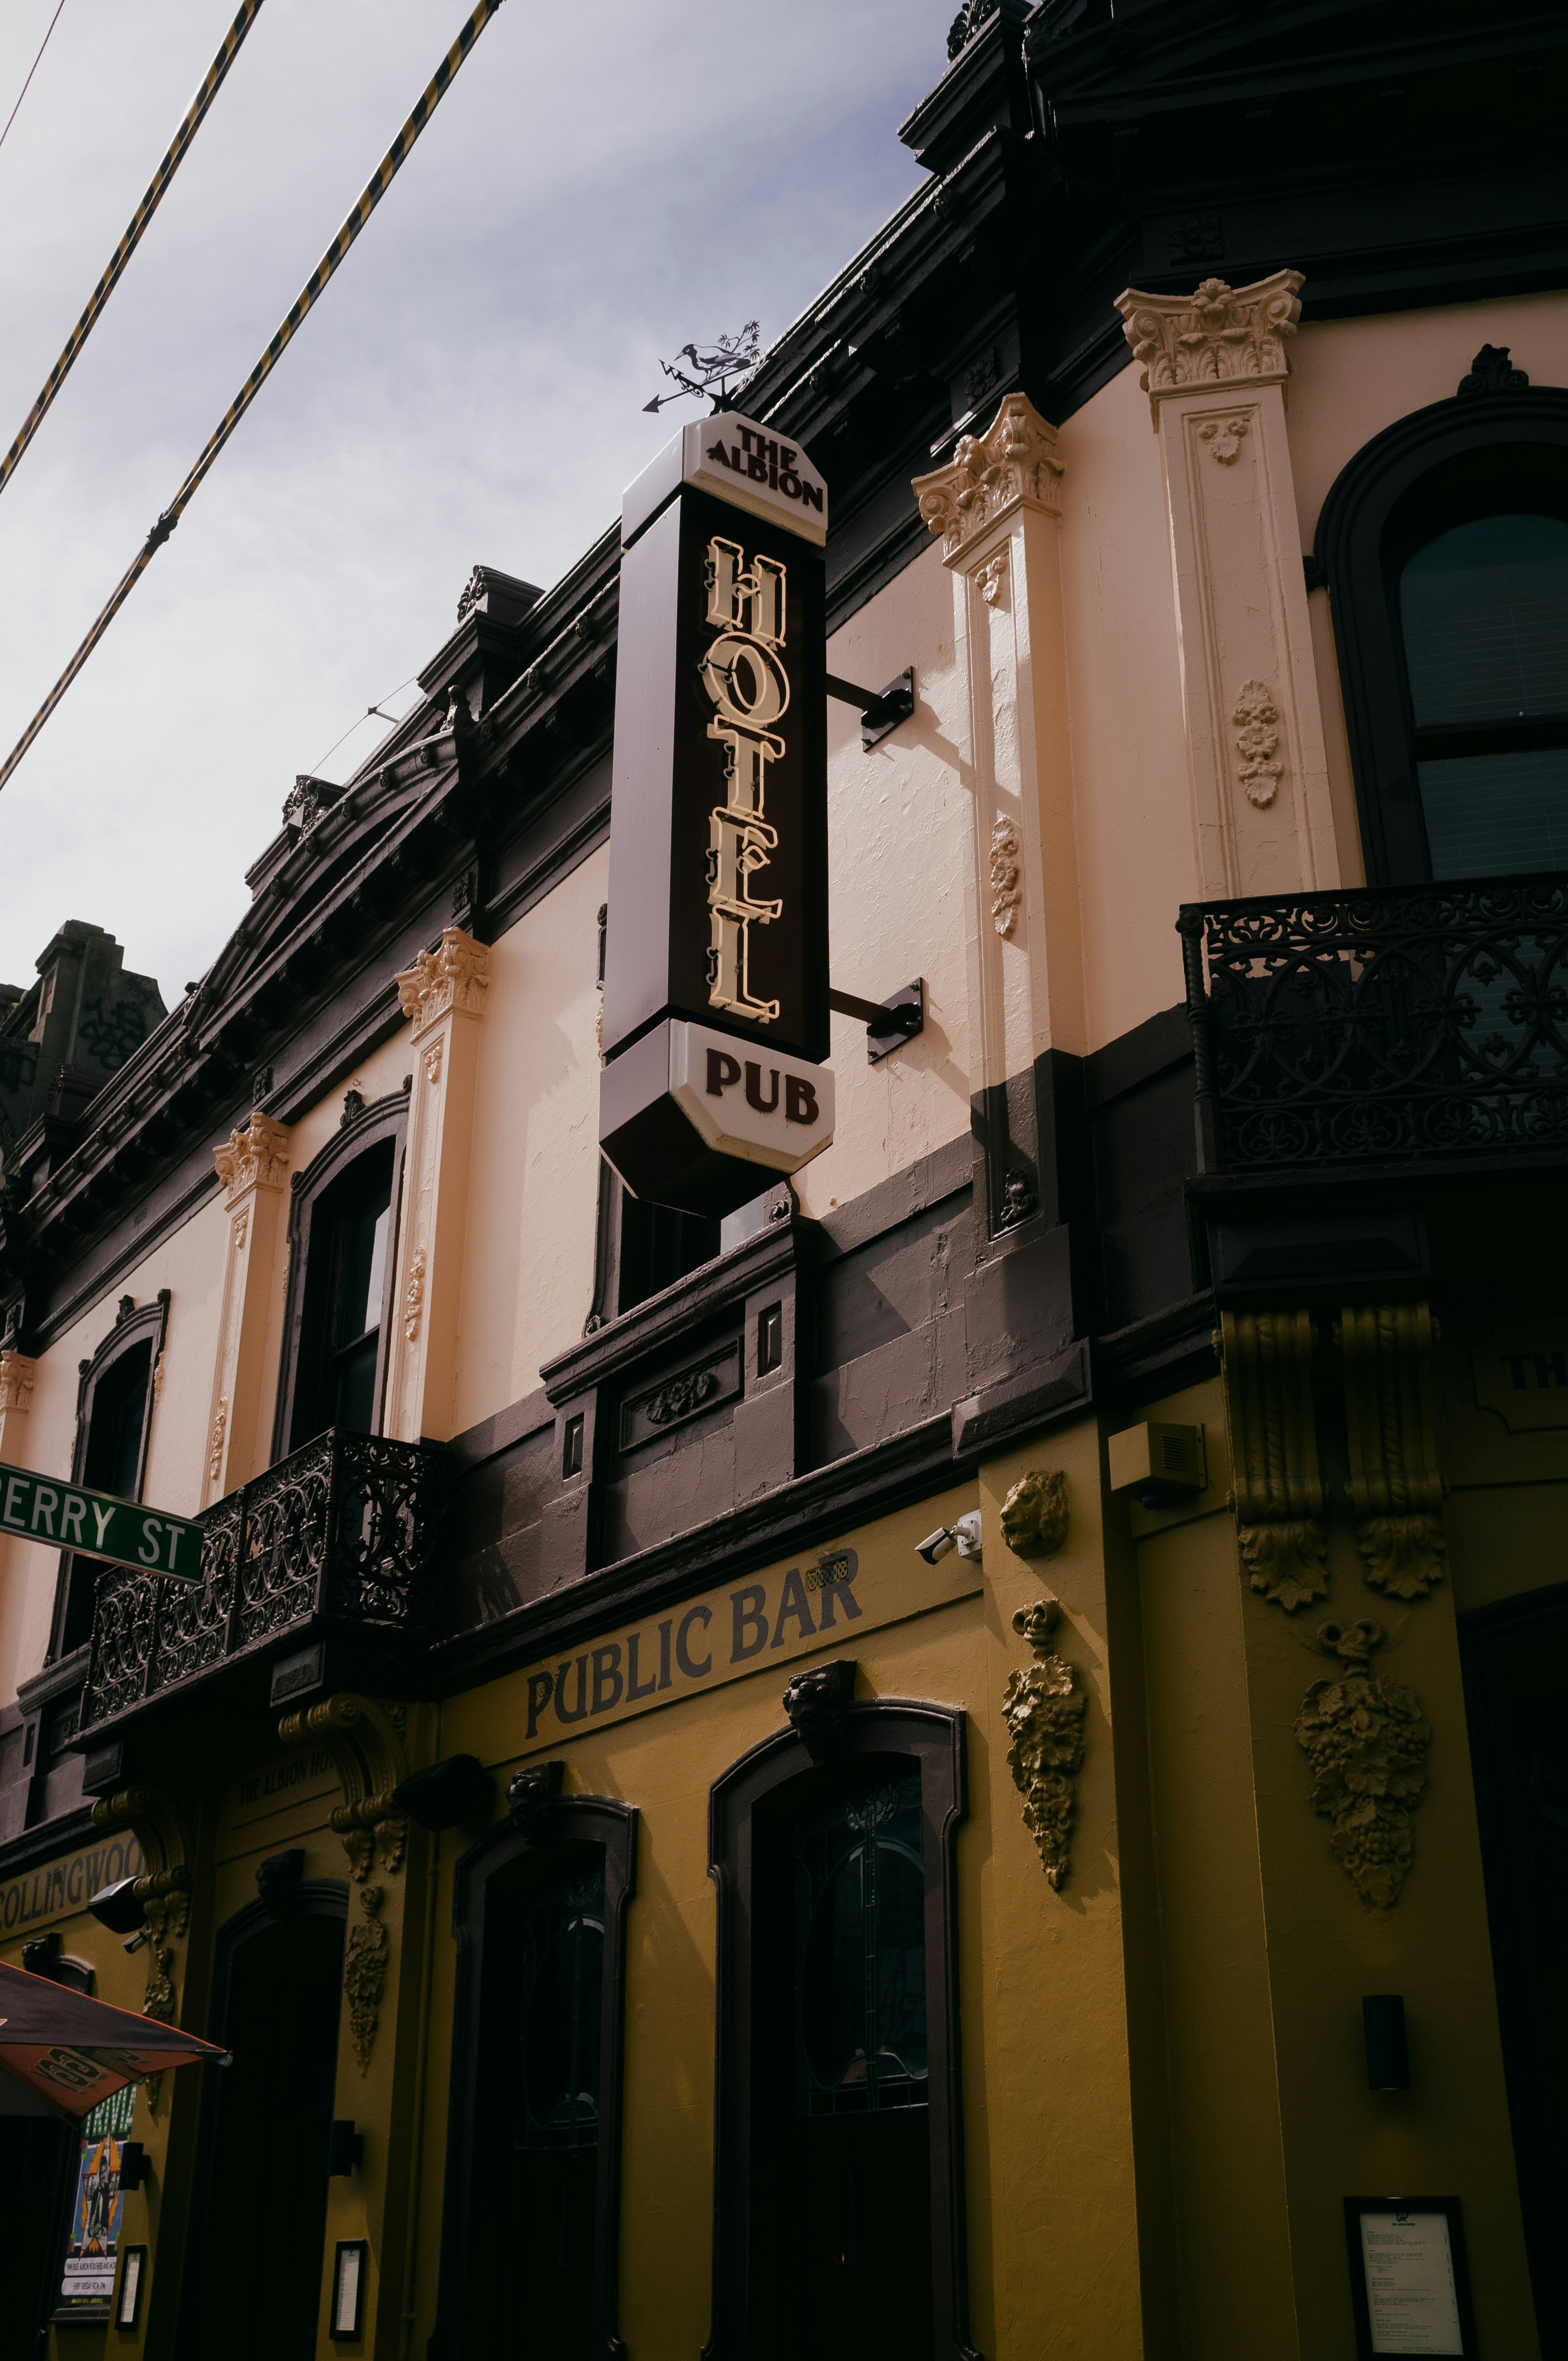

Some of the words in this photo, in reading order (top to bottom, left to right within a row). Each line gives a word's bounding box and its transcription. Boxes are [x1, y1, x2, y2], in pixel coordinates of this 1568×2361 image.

[706, 439, 824, 513] ALBION
[736, 423, 798, 476] THE
[701, 535, 790, 1024] HOTEL
[706, 1048, 819, 1124] PUB
[0, 1476, 116, 1549] ERRY
[138, 1518, 186, 1569] ST
[525, 1606, 713, 1739] PUBLIC
[730, 1548, 863, 1664] BAR
[239, 1777, 260, 1806] THE
[262, 1757, 308, 1797] ALBION
[310, 1750, 333, 1778] HO
